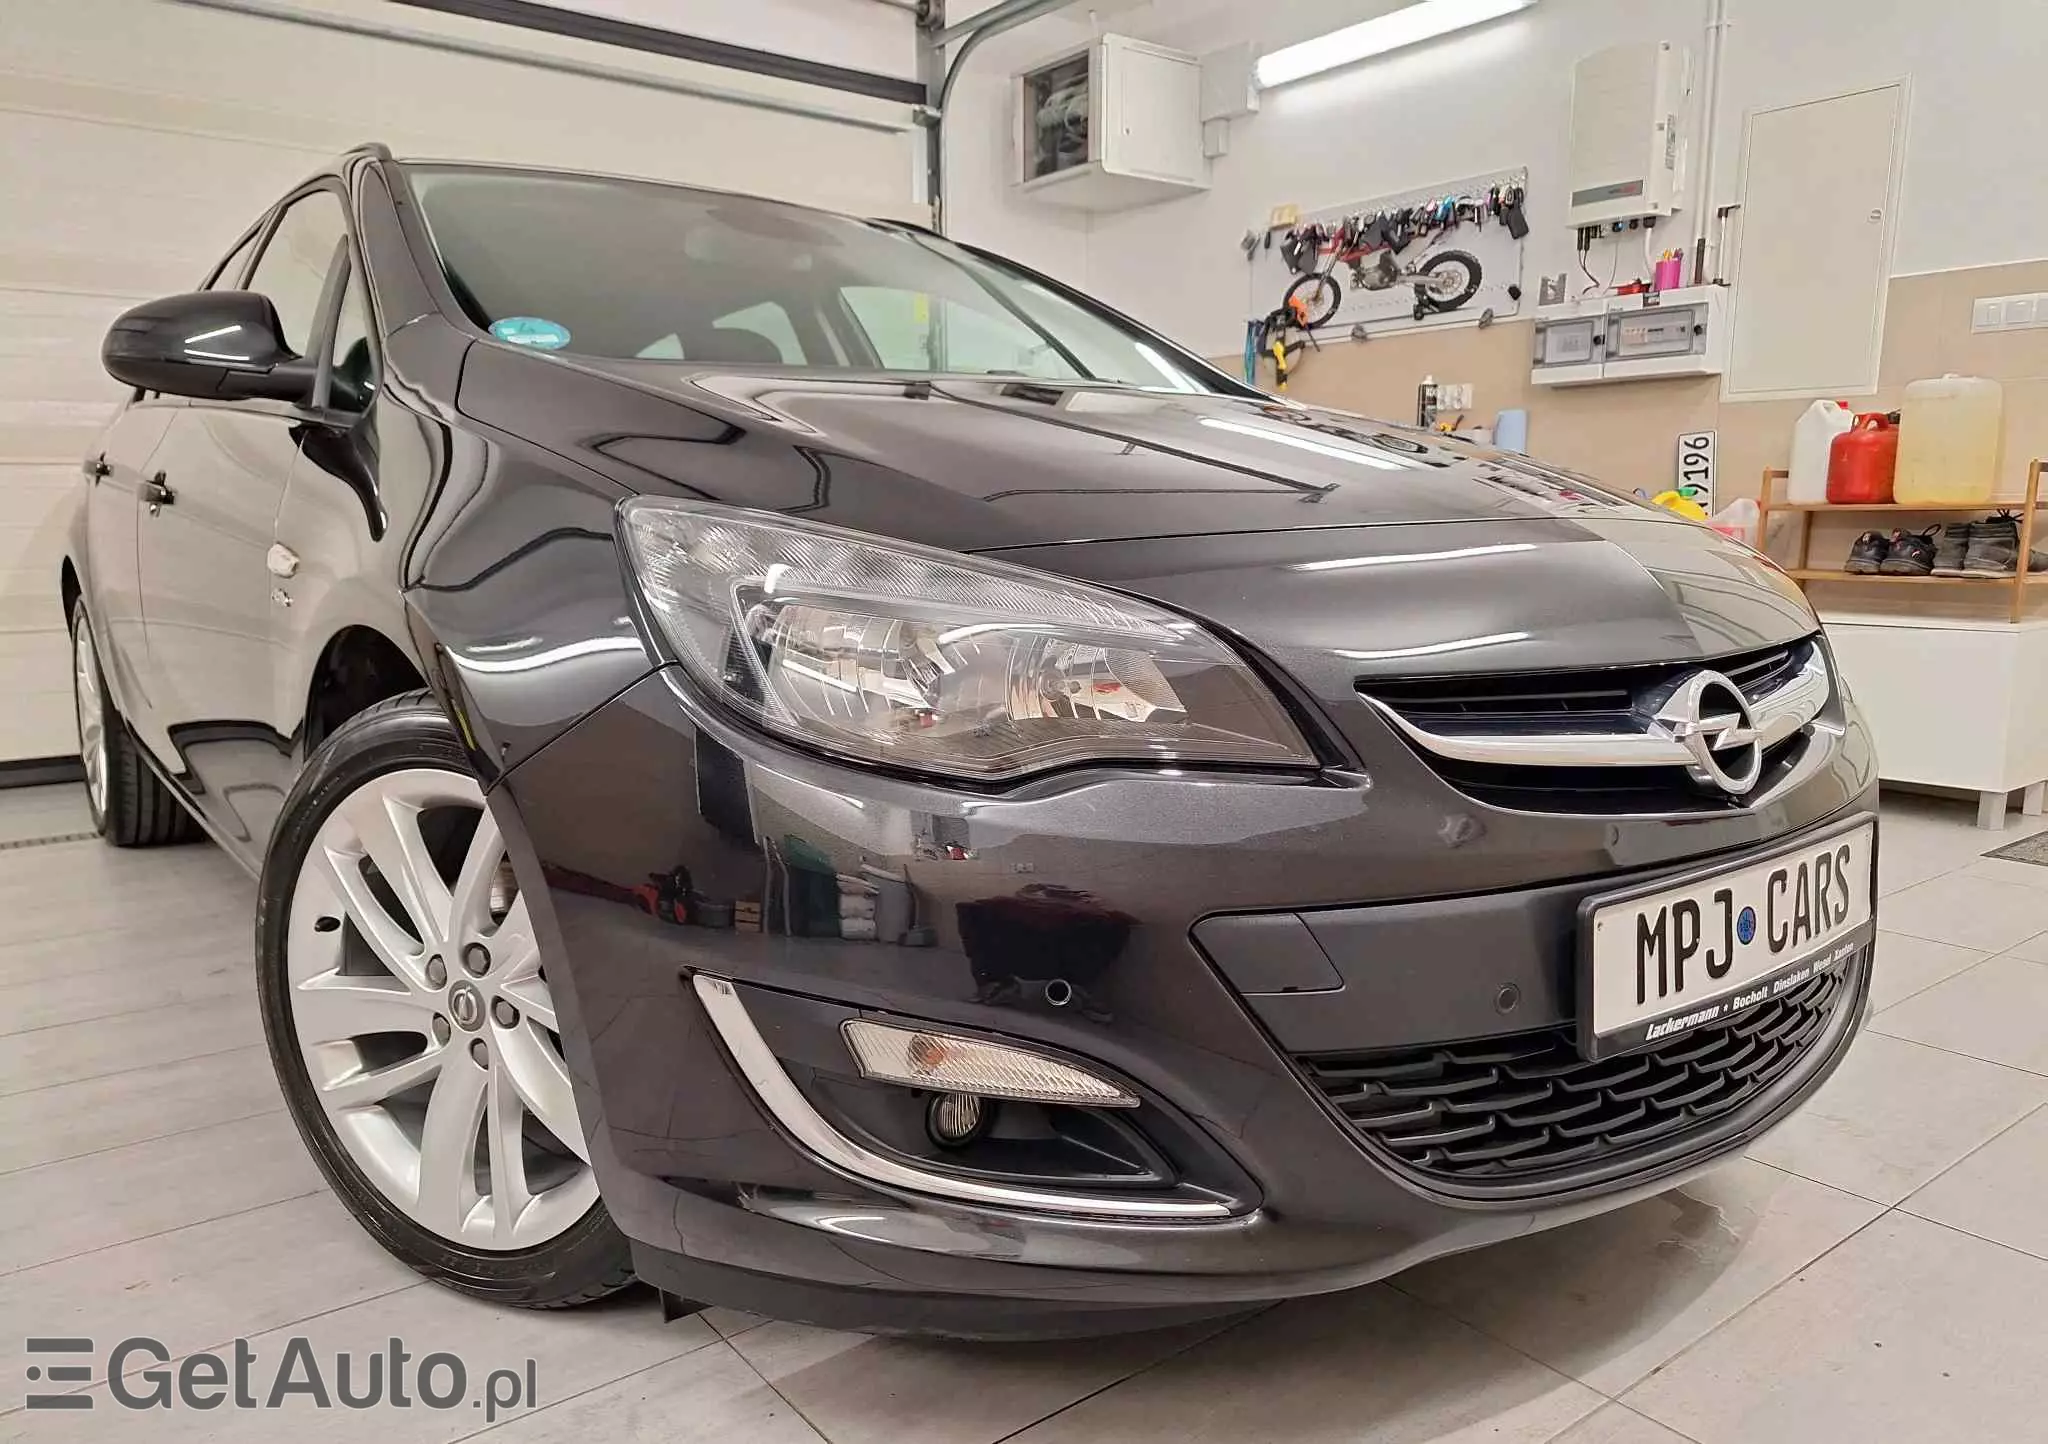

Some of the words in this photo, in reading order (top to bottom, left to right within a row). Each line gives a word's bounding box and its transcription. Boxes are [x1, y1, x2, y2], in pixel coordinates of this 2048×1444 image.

[1683, 436, 1710, 516] 9196
[1636, 887, 1733, 1005] MPJ
[1767, 844, 1850, 953] CARS
[1645, 1005, 1720, 1041] Lackermann
[1733, 985, 1768, 1010] Bocholt
[1773, 968, 1810, 994] Dinslaken
